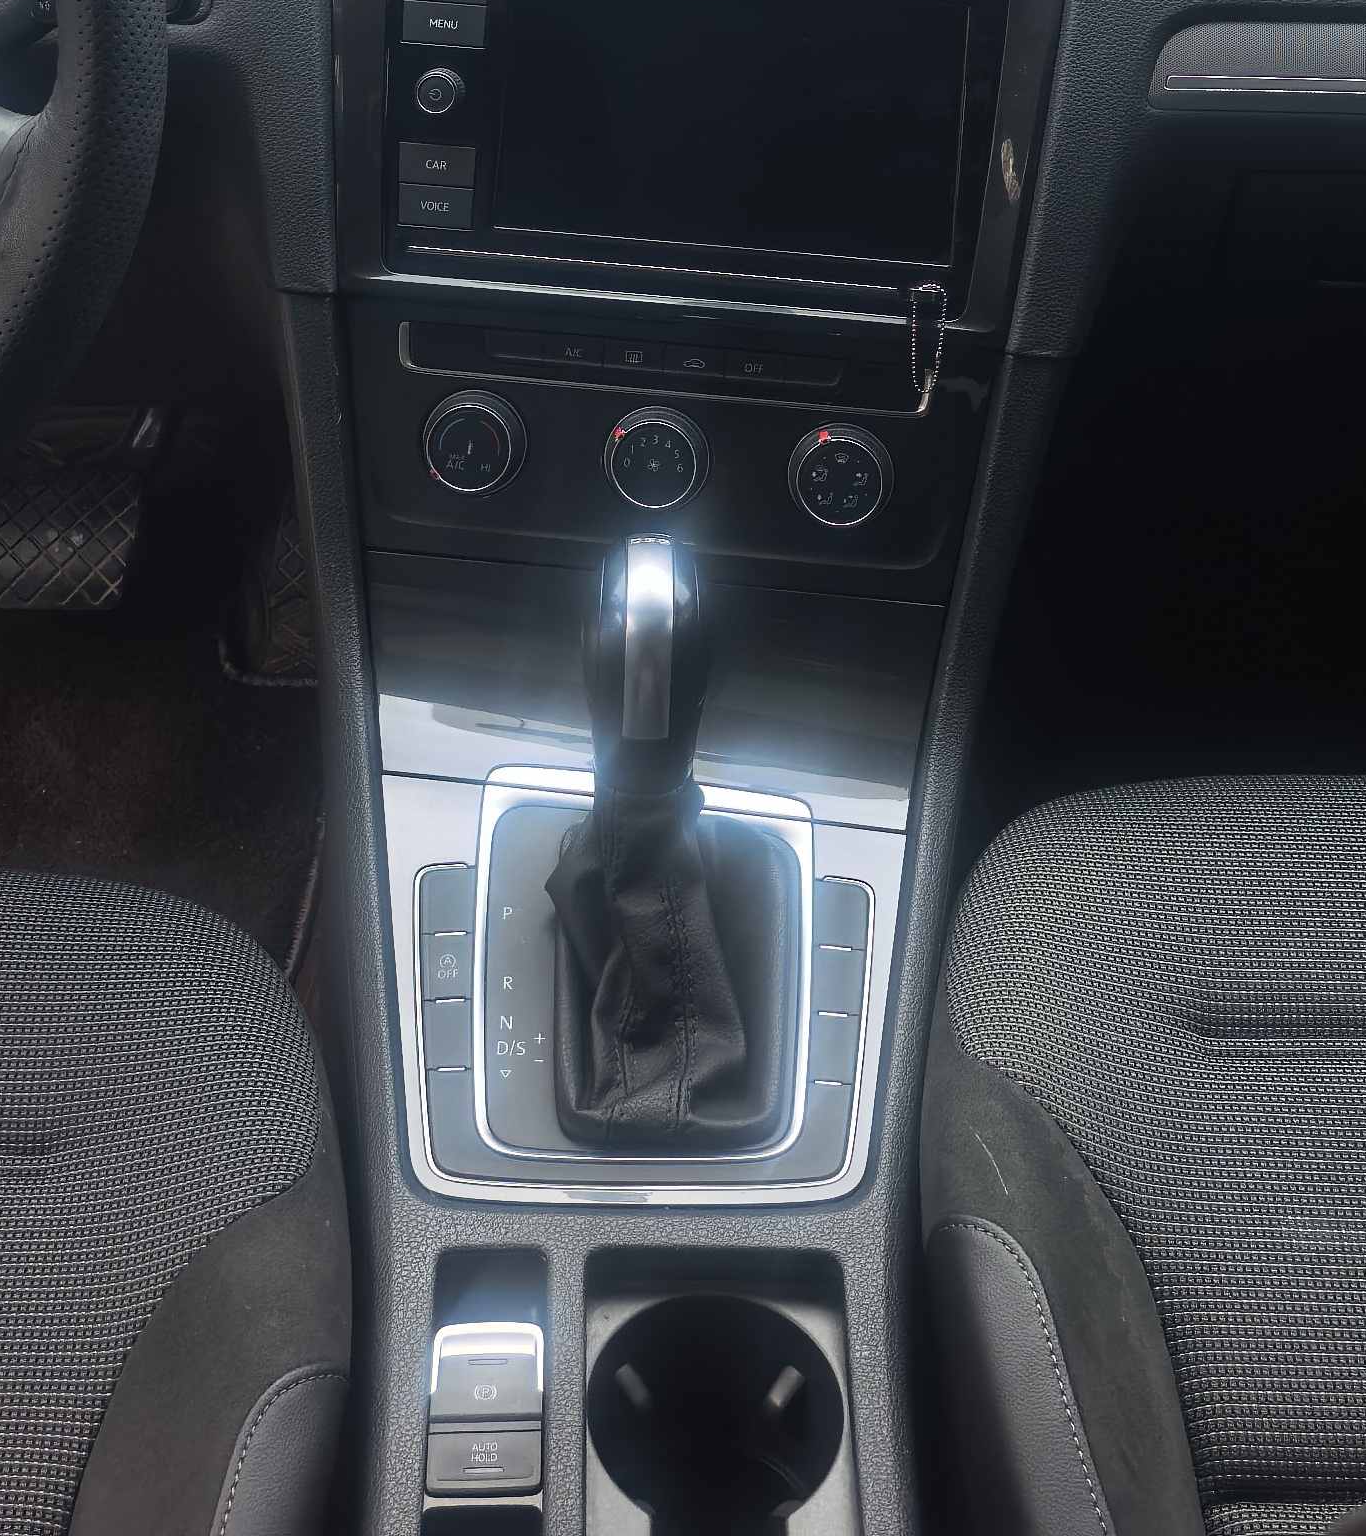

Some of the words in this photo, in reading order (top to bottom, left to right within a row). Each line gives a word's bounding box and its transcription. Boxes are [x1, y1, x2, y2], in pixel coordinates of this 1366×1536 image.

[429, 18, 458, 30] MENU
[426, 159, 447, 170] CAR
[420, 200, 450, 212] VOICE
[502, 906, 513, 919] P
[437, 968, 458, 979] OFF
[503, 976, 513, 990] R
[500, 1016, 513, 1030] N
[497, 1041, 526, 1056] D/S
[472, 1442, 497, 1452] AUTO
[471, 1453, 497, 1462] HOLD
